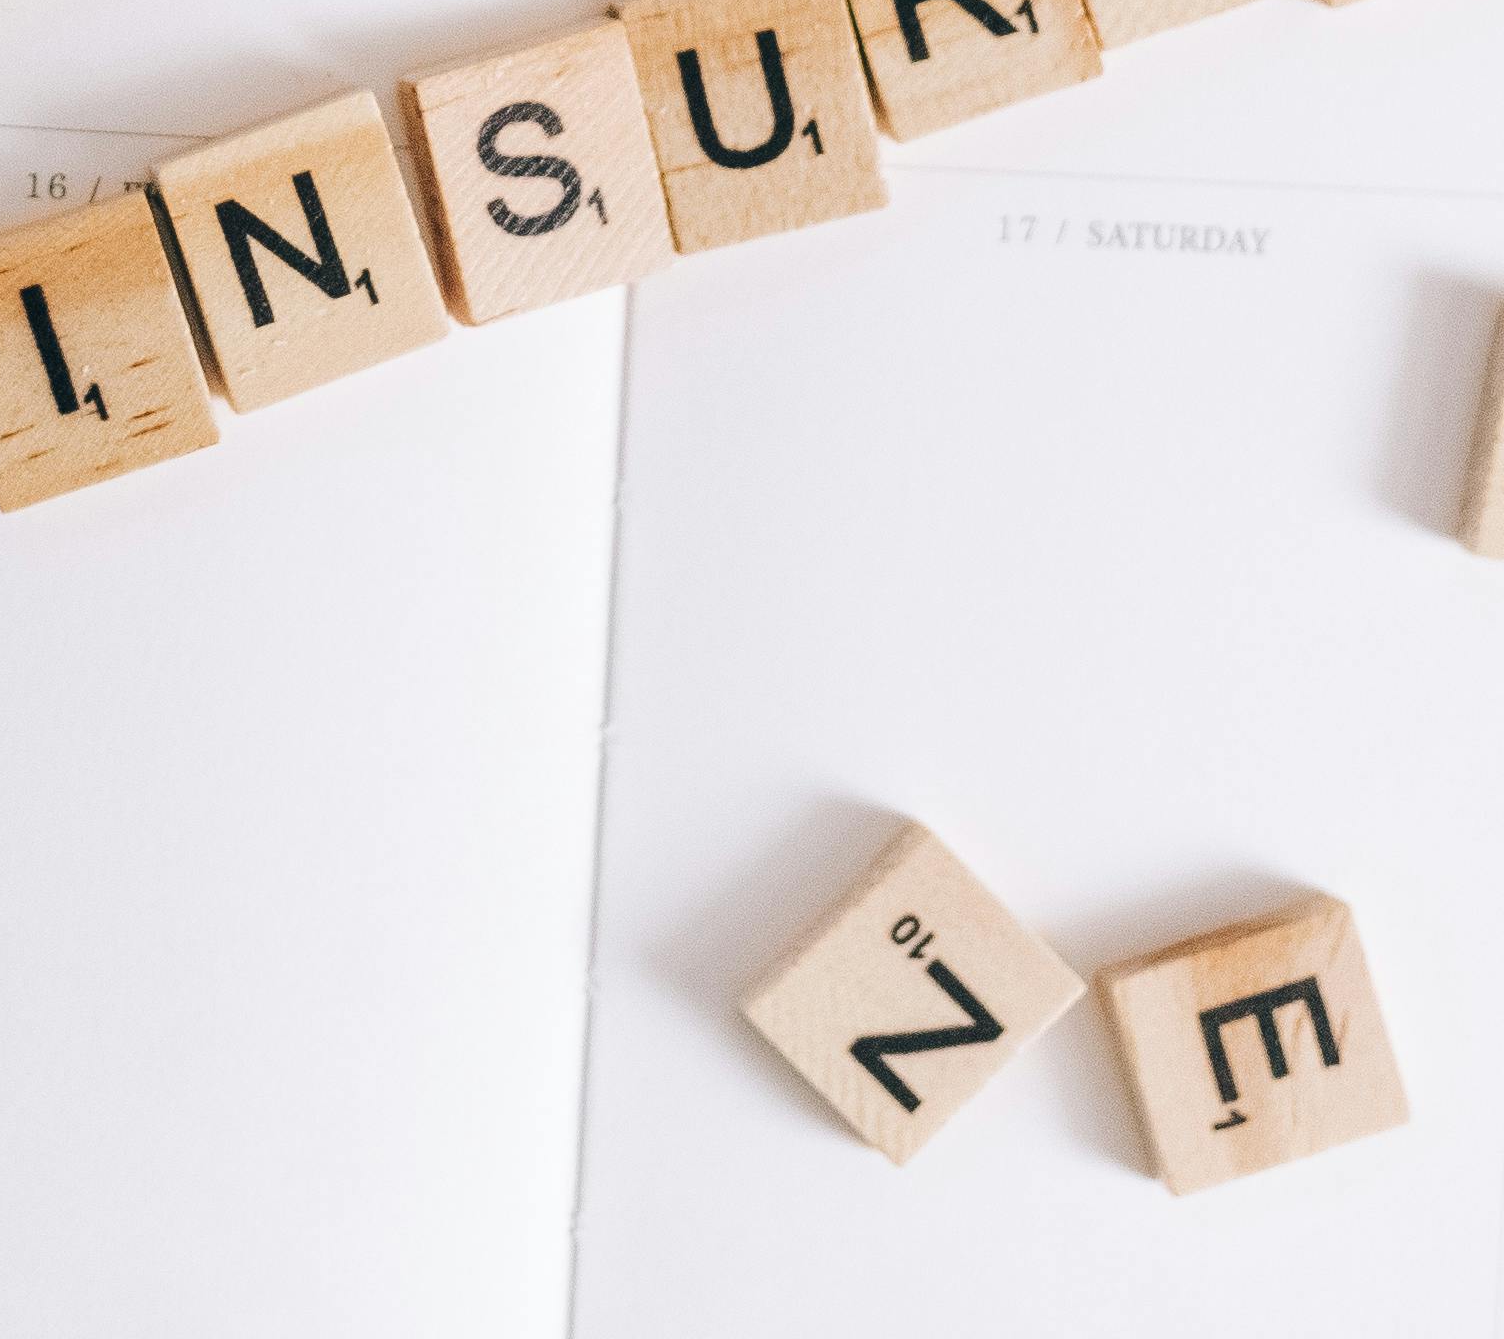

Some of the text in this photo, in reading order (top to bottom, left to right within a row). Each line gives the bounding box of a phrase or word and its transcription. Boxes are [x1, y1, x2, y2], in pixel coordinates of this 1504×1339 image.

[29, 173, 67, 201] 16
[999, 214, 1038, 243] 17
[1087, 221, 1270, 256] SATURDAY
[847, 958, 1006, 1114] Z
[1197, 975, 1341, 1104] E
